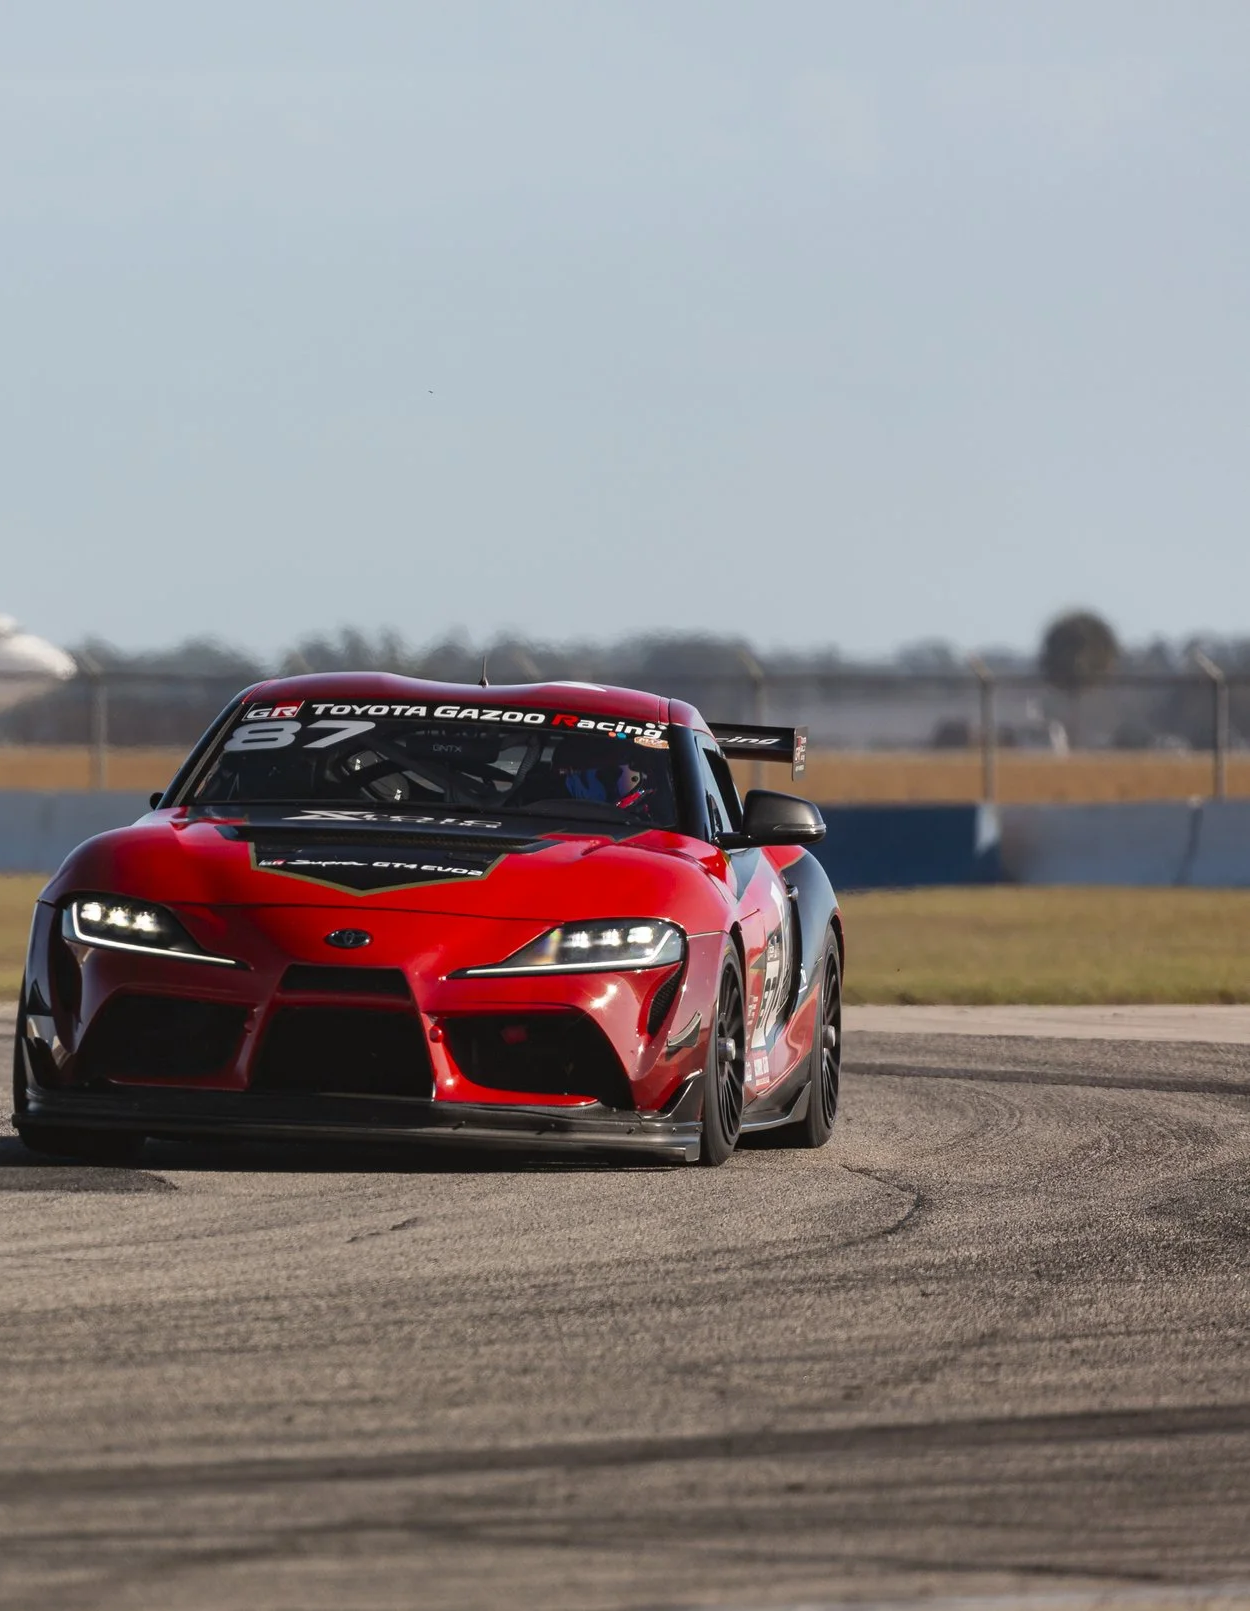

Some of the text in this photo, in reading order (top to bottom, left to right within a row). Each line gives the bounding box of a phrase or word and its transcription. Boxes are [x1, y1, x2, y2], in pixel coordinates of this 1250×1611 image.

[224, 719, 377, 751] 87
[246, 703, 663, 740] GR TOYOTA GAZOO Racing
[287, 859, 369, 868] Supra
[372, 861, 418, 870] GT4
[420, 864, 484, 877] EVO2
